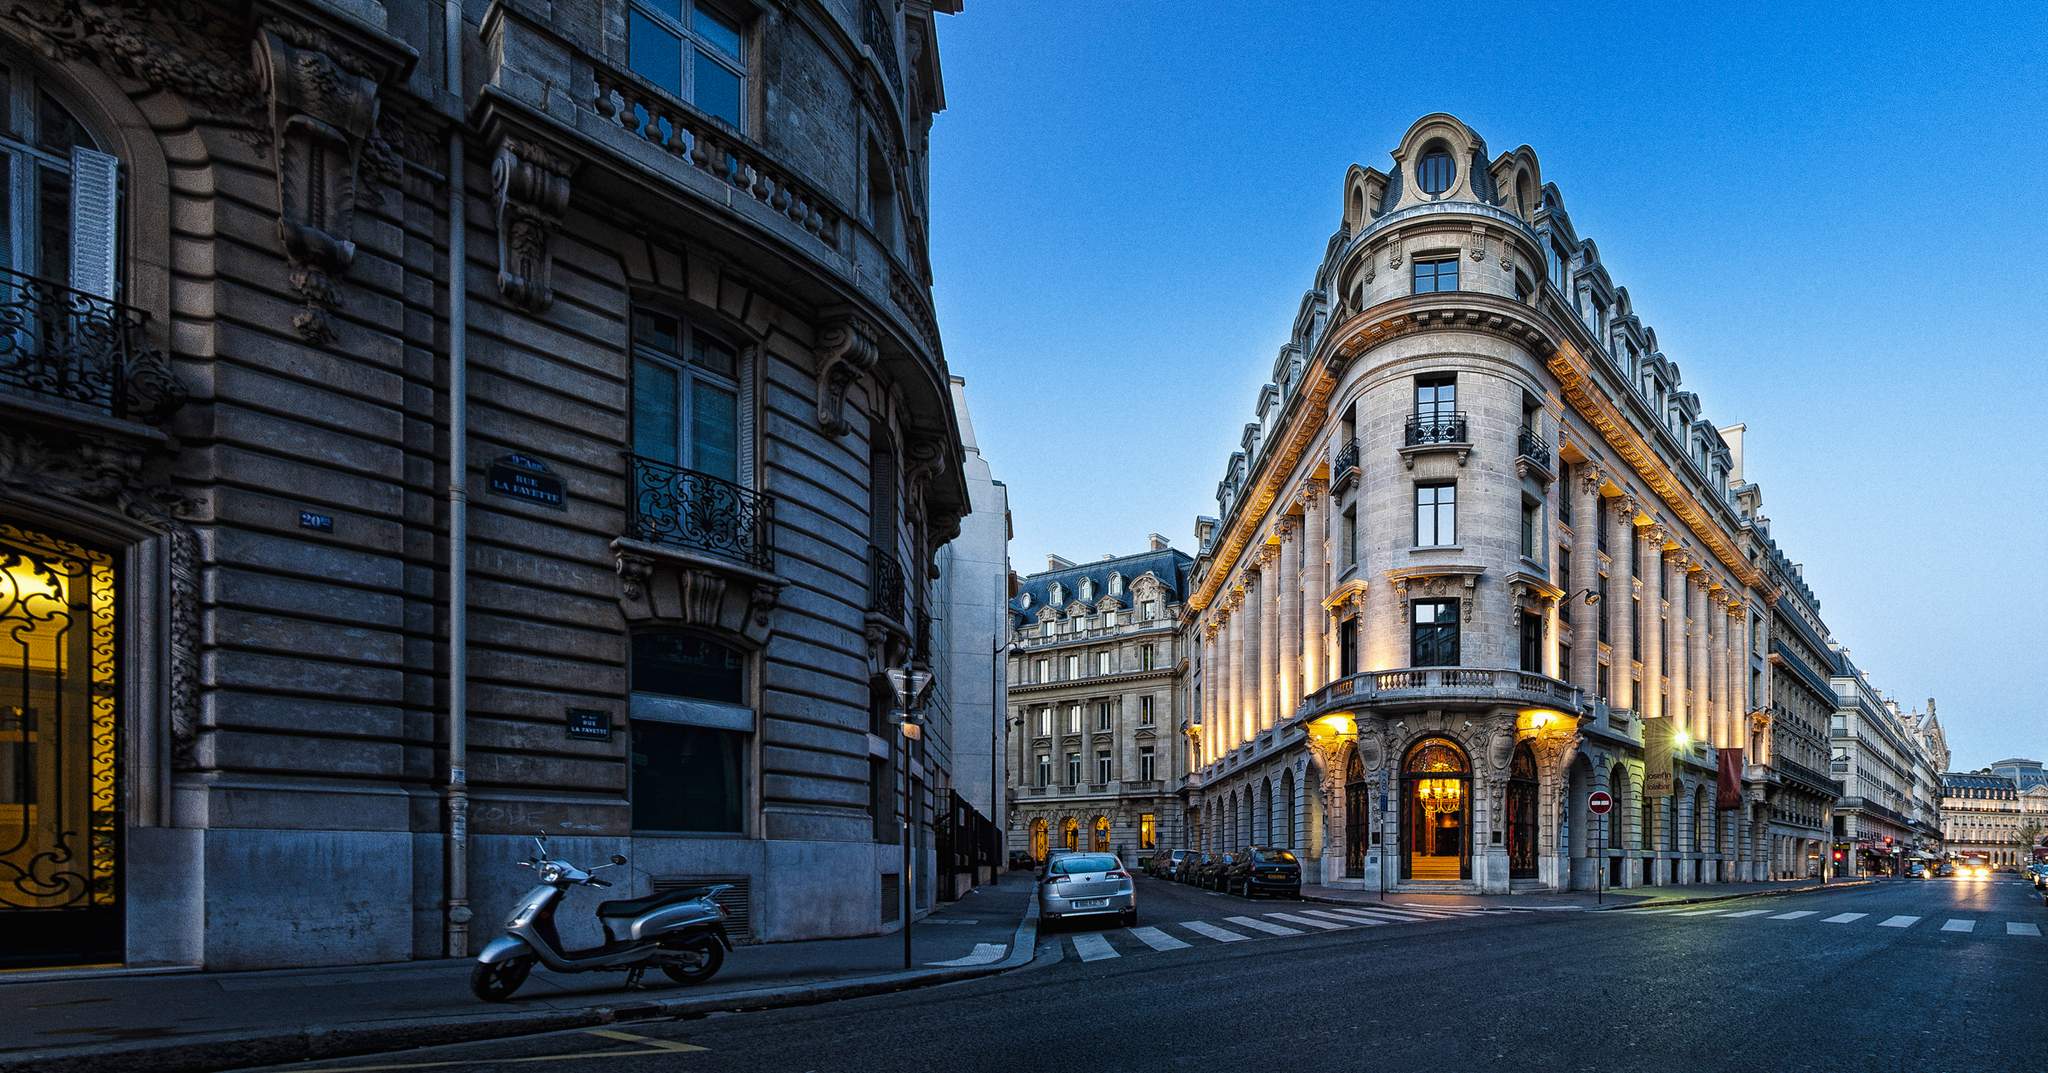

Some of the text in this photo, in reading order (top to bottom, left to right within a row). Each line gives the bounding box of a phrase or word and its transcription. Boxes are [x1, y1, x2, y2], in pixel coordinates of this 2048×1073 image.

[515, 474, 538, 487] RUE
[493, 479, 560, 502] LA FAYETTE
[581, 727, 608, 735] FAYETTE
